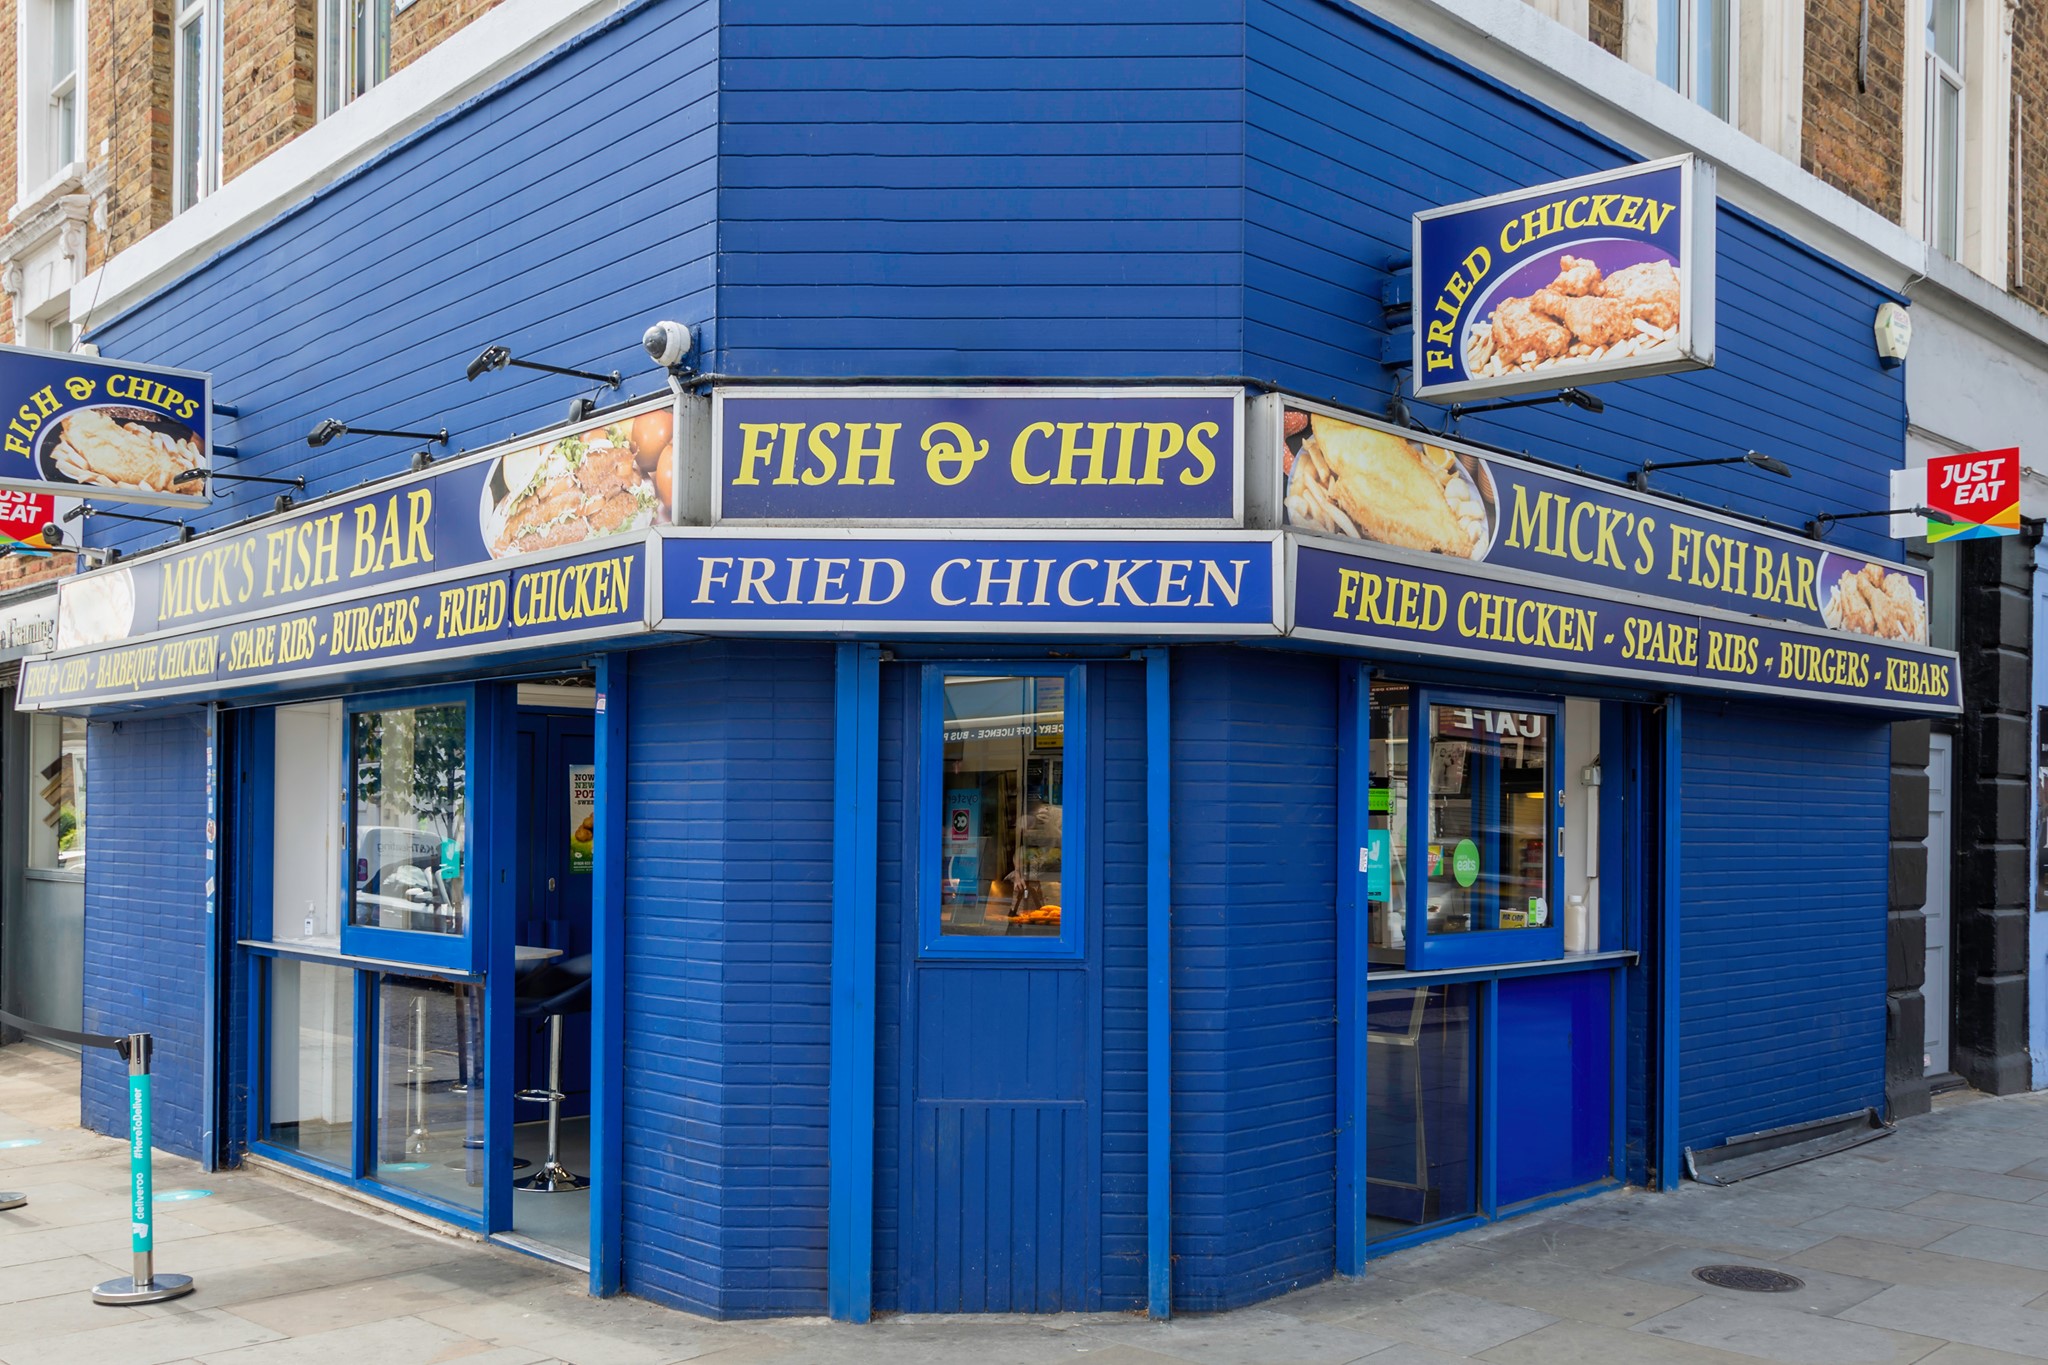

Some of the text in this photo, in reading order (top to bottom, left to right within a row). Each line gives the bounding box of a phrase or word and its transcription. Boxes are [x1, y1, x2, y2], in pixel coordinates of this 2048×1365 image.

[1426, 194, 1676, 372] FRIED CHICKEN
[4, 374, 200, 459] FISH & CHIPS
[732, 421, 1219, 487] FISH & CHIPS
[1940, 458, 2006, 489] JUST
[1954, 480, 2006, 505] EAT
[158, 488, 434, 621] MICK'S FISH BAR
[691, 556, 1250, 607] FRIED CHICKEN
[1504, 483, 1818, 611] MICK'S FISH BAR
[7, 614, 54, 650] Framing
[24, 665, 50, 698] FISH
[59, 657, 90, 694] CHIPS
[96, 646, 158, 690] BARBEQUE
[158, 635, 220, 681] CHICKEN
[228, 624, 276, 672] SPARE
[278, 615, 317, 664] RIBS
[330, 595, 420, 656] BURGERS
[436, 578, 507, 640] FRIED
[513, 555, 634, 627] CHICKEN
[1333, 567, 1447, 632] FRIED
[1457, 590, 1597, 652] CHICKEN
[1621, 617, 1698, 667] SPARE
[1706, 630, 1759, 675] RIBS
[1778, 642, 1869, 688] BURGERS
[1885, 656, 1949, 698] KEBABS
[1457, 858, 1476, 871] eats
[132, 1088, 144, 1220] deliveroo #HereToDeliver
